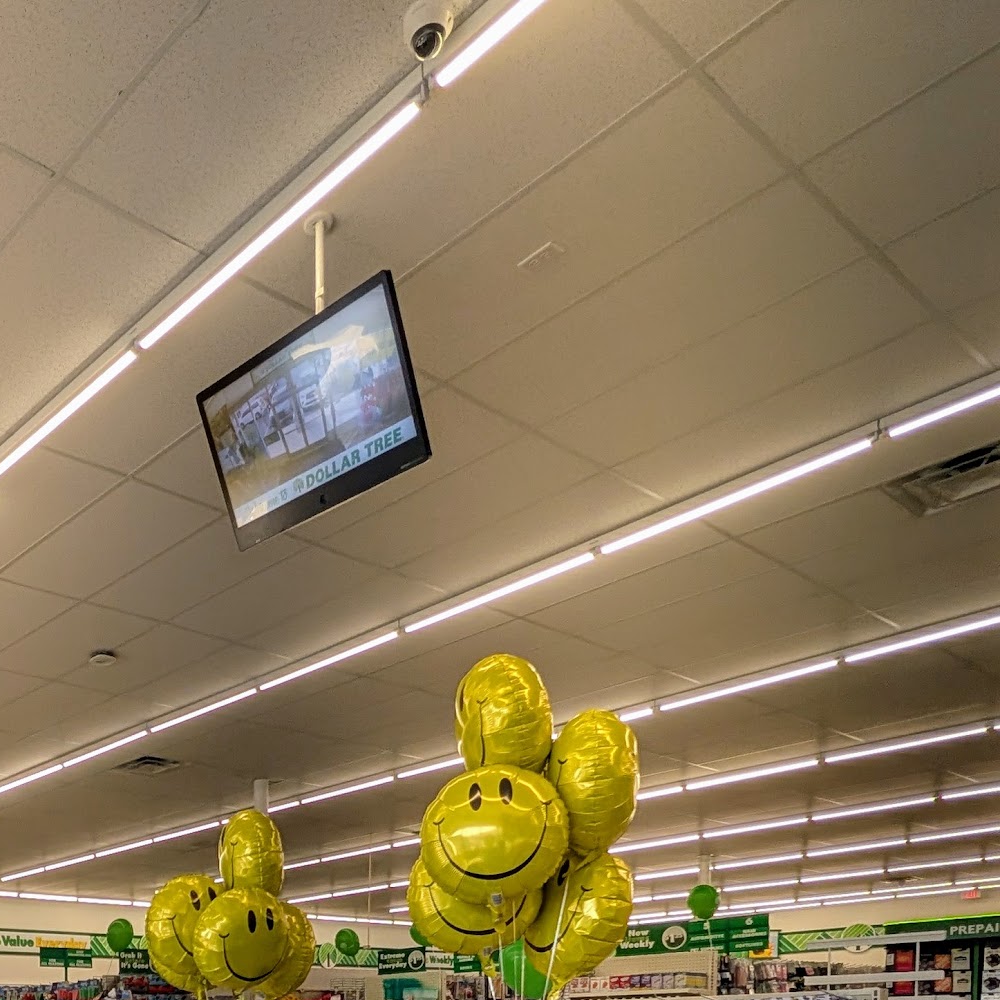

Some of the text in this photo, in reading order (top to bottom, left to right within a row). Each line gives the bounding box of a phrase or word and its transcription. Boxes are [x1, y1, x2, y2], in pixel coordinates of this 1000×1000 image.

[305, 426, 402, 490] DOLLAR TREE
[628, 929, 649, 938] New
[1, 935, 34, 947] Value
[620, 940, 655, 950] Weekly
[379, 961, 407, 970] Everyday
